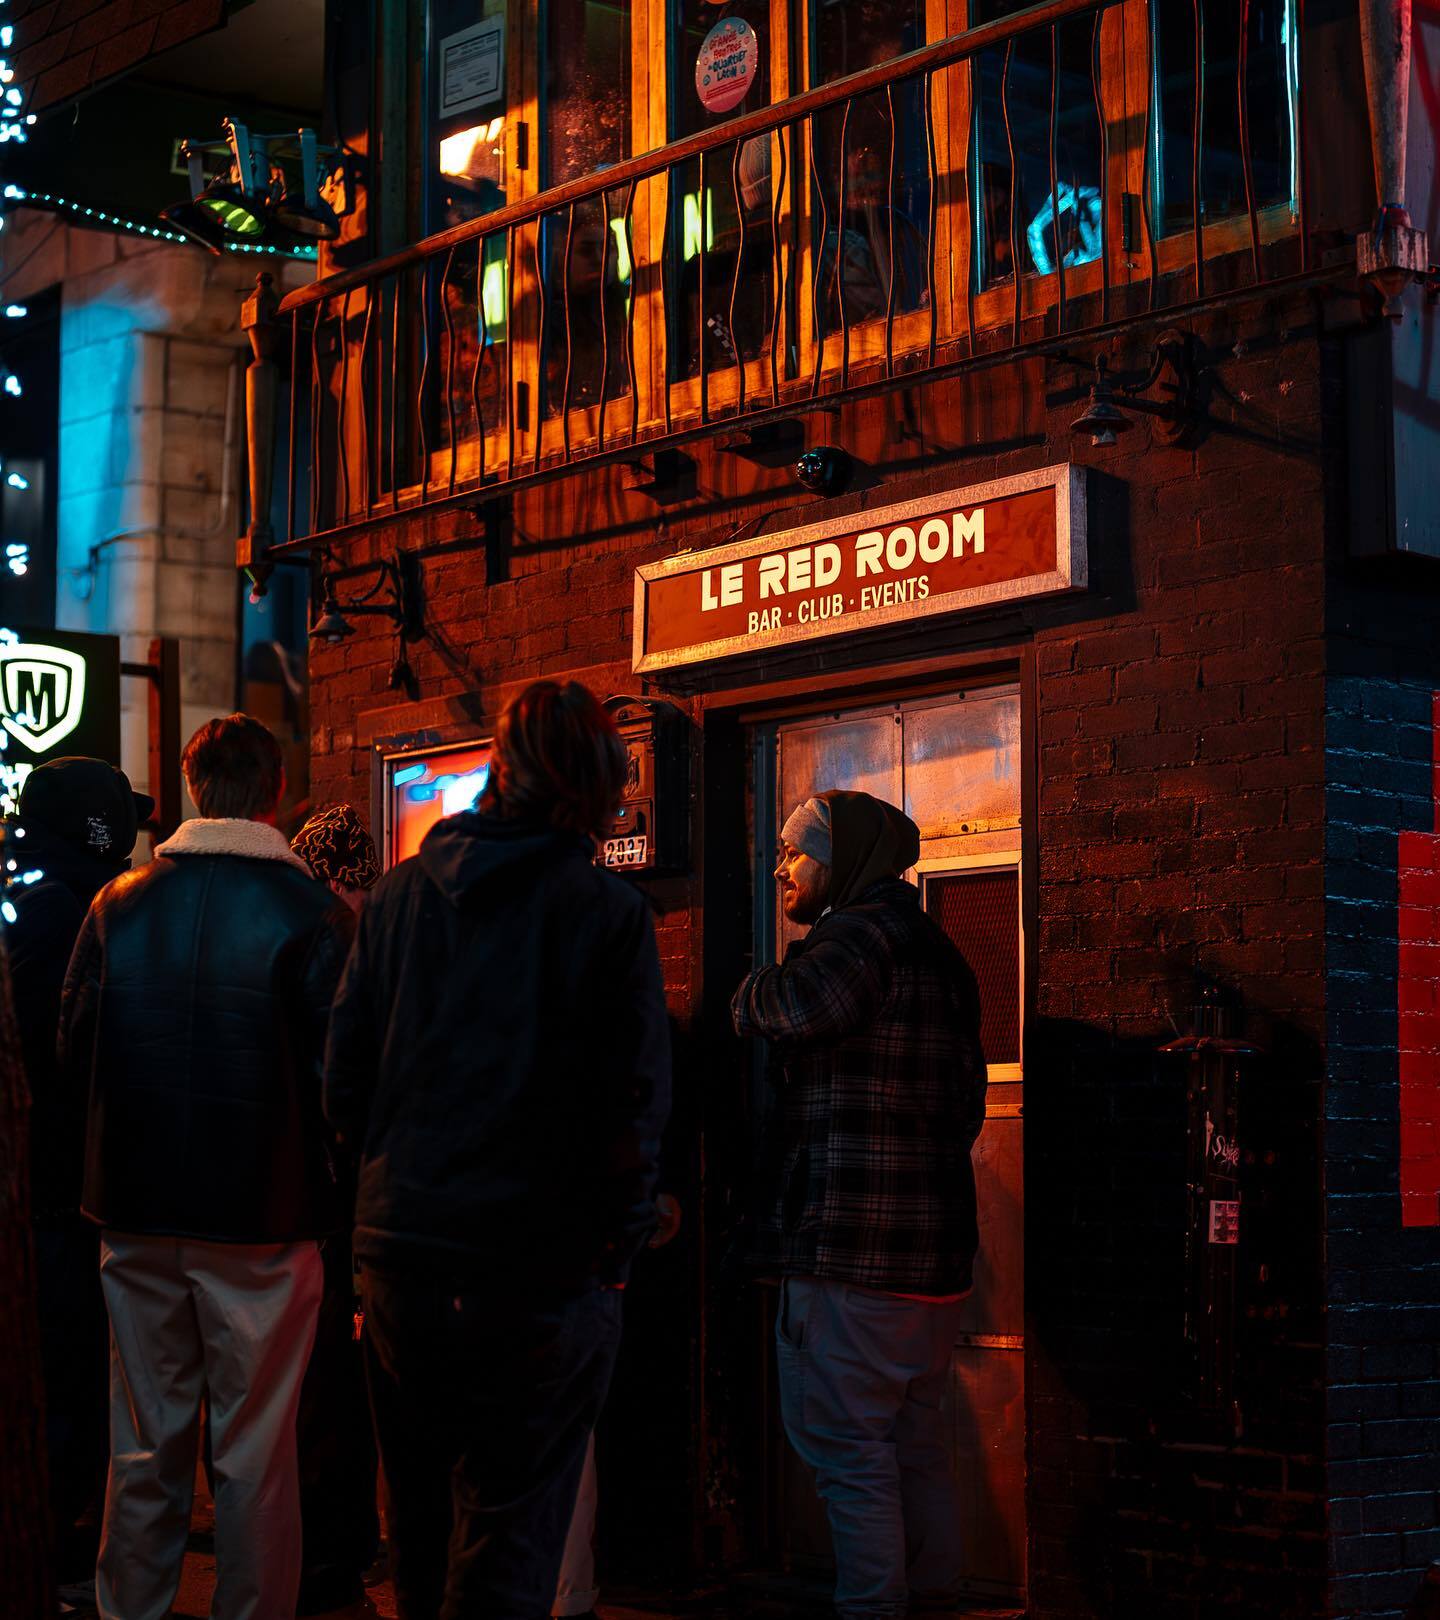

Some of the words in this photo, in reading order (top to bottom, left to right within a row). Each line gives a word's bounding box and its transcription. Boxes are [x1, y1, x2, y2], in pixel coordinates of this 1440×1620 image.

[701, 563, 744, 611] LE
[758, 543, 842, 599] RED
[854, 507, 985, 577] ROOM
[748, 606, 782, 634] BAR
[797, 593, 843, 623] CLUB
[860, 575, 930, 611] EVENTS
[606, 839, 645, 865] 2037
